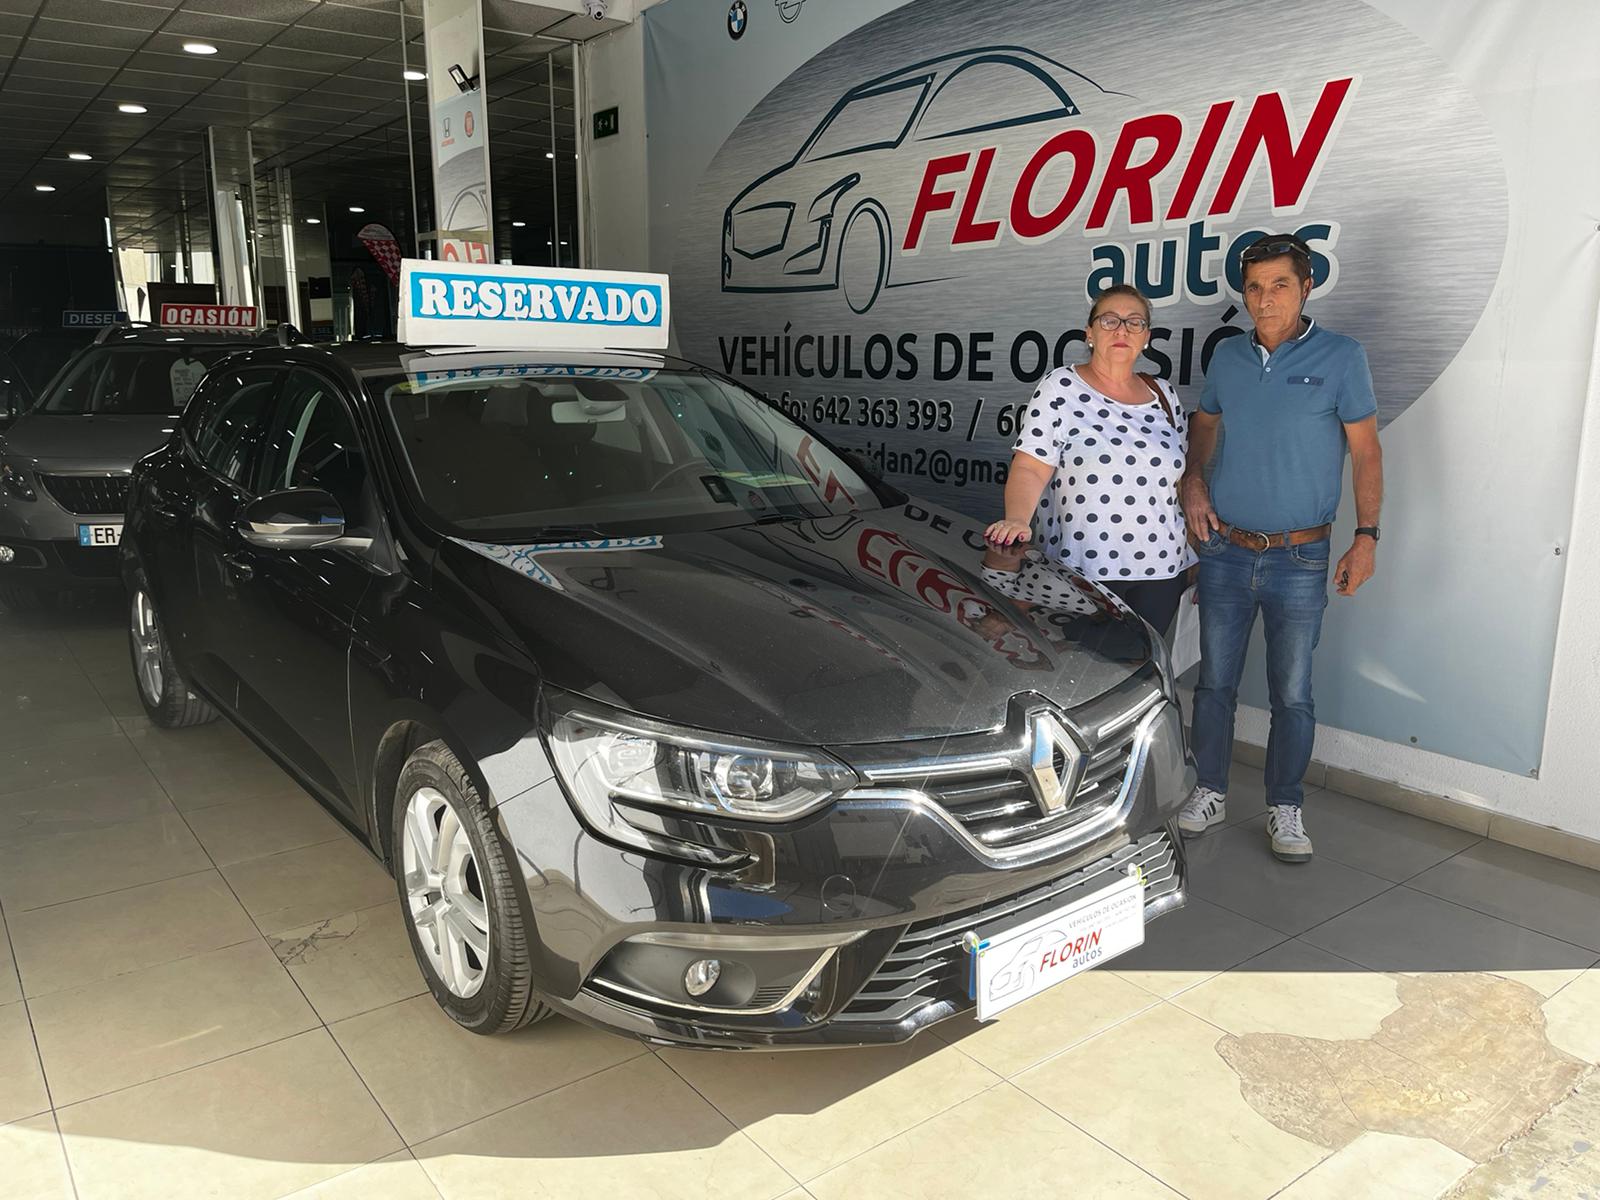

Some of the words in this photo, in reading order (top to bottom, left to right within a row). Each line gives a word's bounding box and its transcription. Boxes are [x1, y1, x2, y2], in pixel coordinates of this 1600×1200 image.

[902, 78, 1353, 250] FLORIN
[69, 313, 122, 325] DIESEL
[166, 307, 253, 326] OCASIÓN
[418, 278, 658, 323] RESERVADO
[718, 321, 919, 381] VEHÍCULOS
[933, 331, 995, 382] DE
[812, 395, 851, 424] 642
[857, 398, 900, 429] 363
[906, 400, 953, 433] 393
[1040, 928, 1103, 972] FLORIN
[1072, 947, 1103, 969] autos
